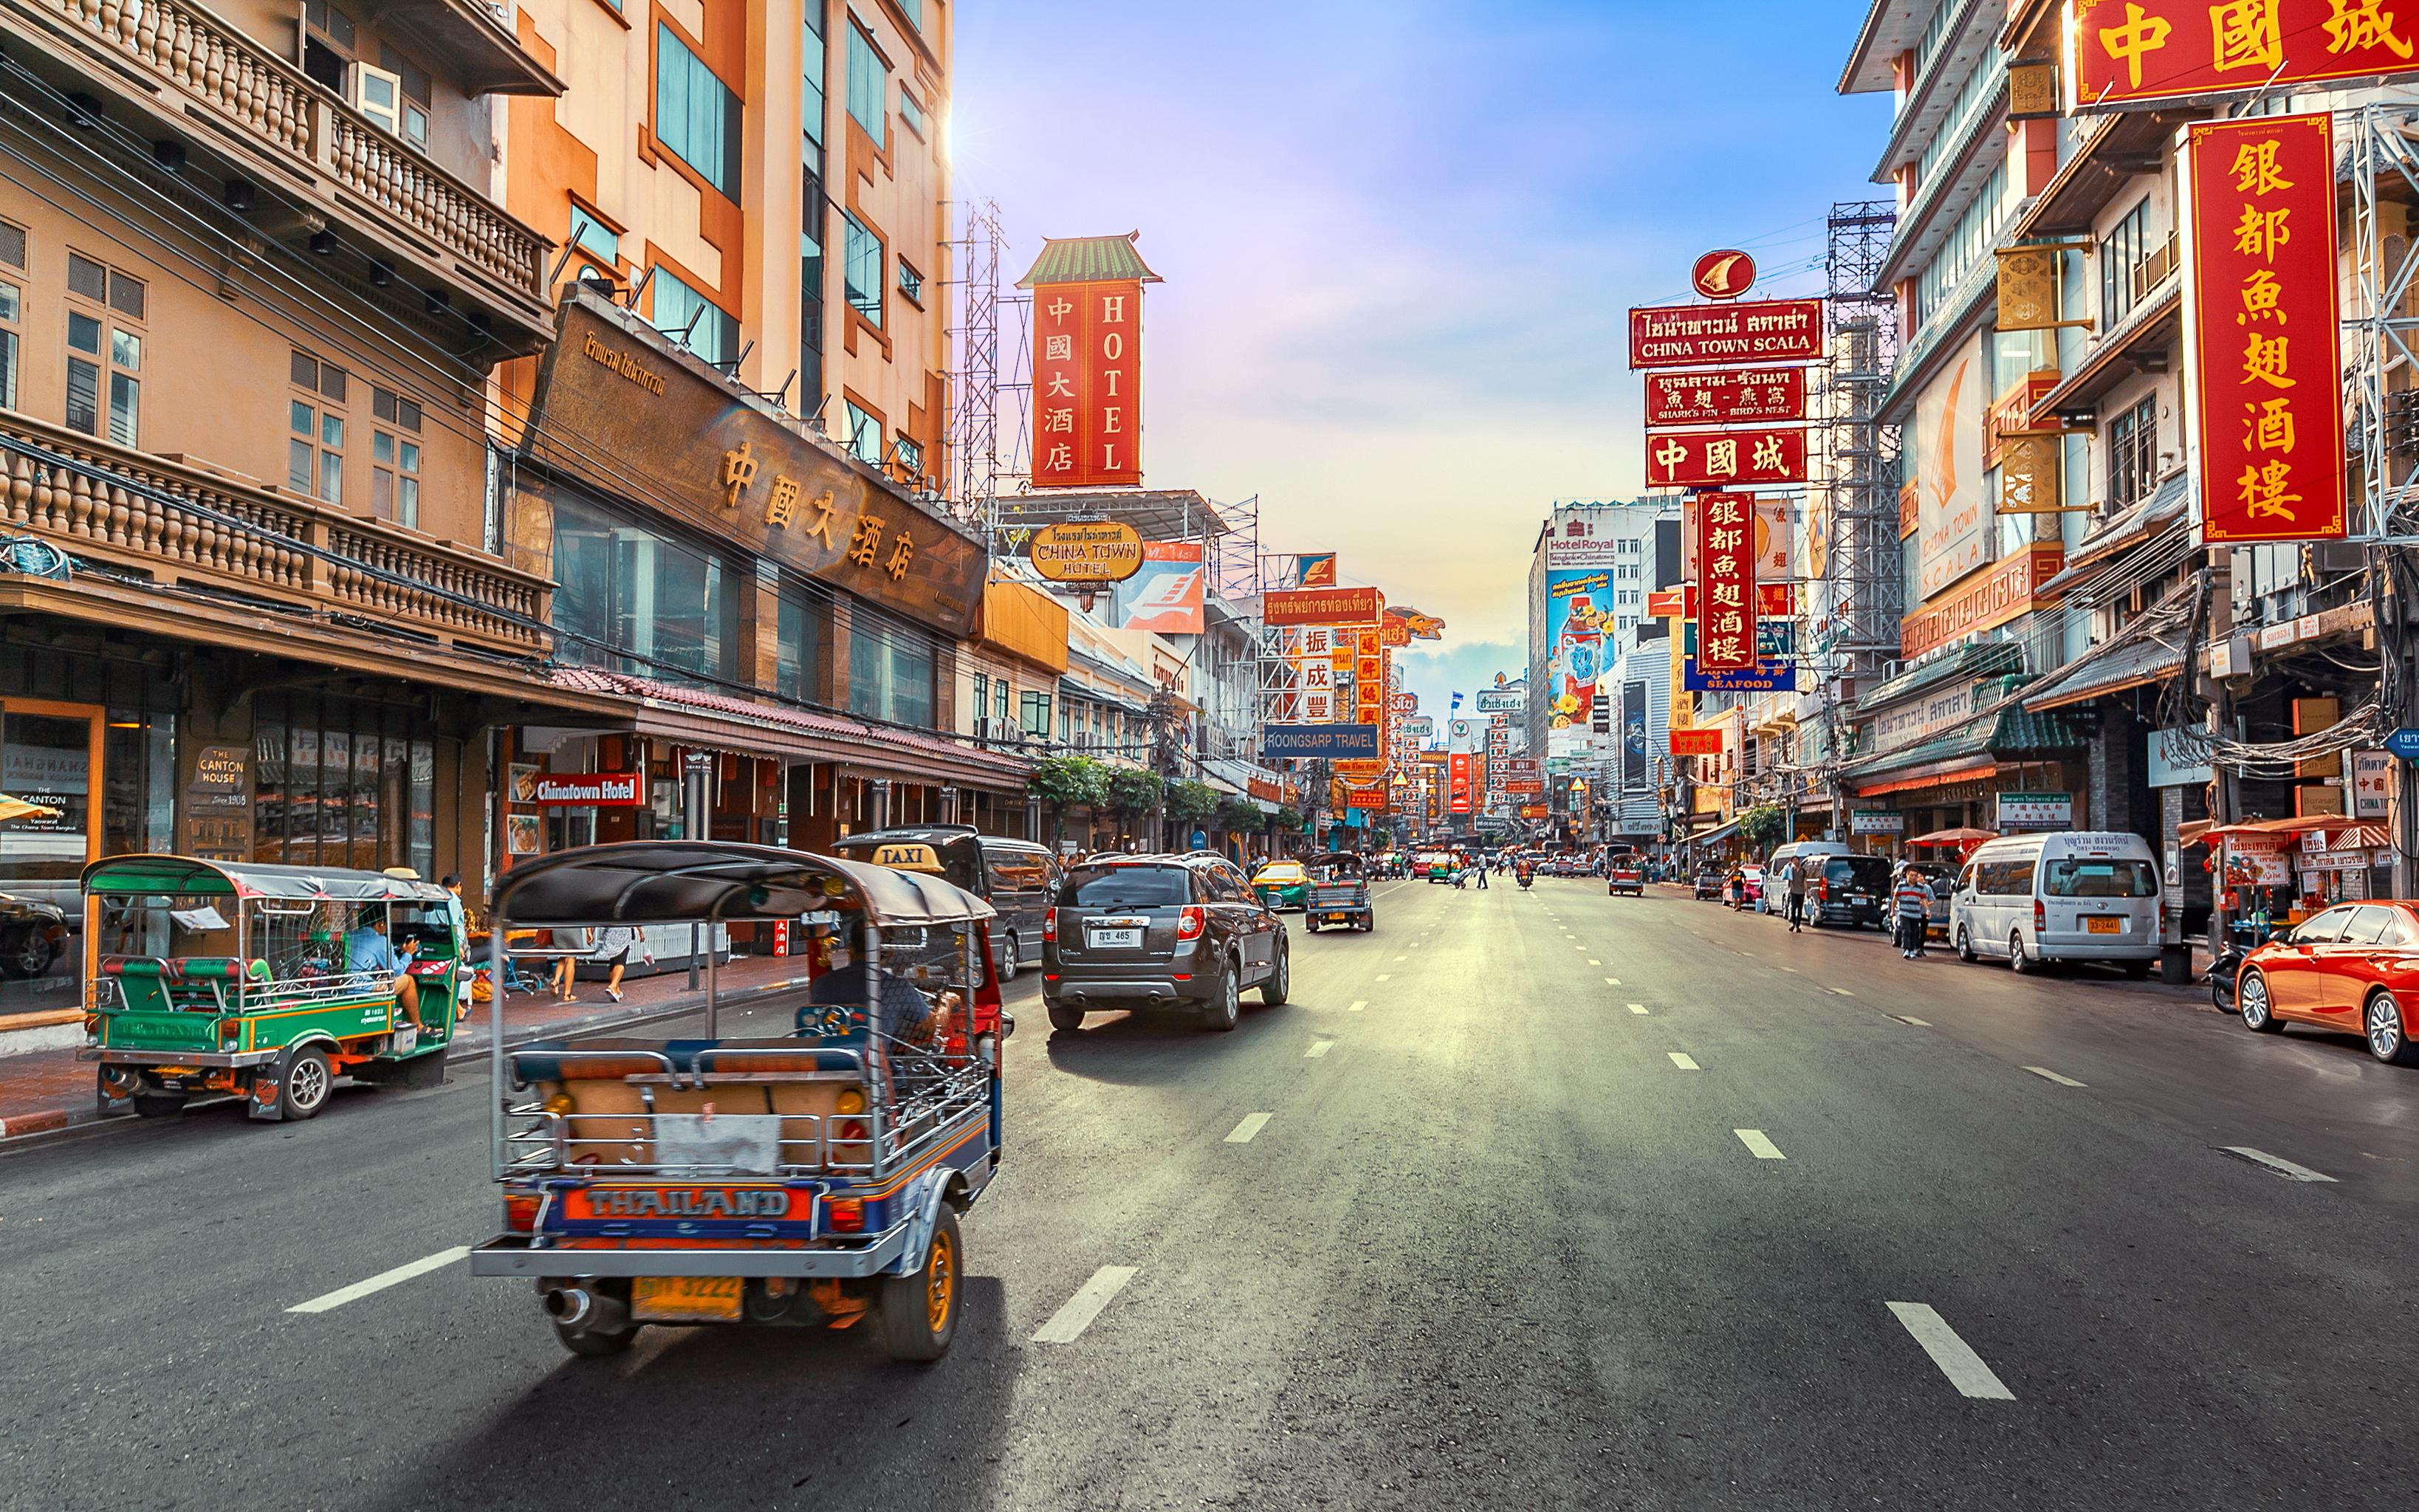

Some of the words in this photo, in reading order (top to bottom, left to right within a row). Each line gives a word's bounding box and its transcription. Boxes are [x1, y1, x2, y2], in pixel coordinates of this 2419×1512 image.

[2099, 0, 2414, 89] 中國城
[1642, 312, 1738, 337] ไชน่าทาวน์
[1747, 308, 1808, 331] สกาล่า
[2228, 139, 2303, 522] 銀都魚翅酒樓
[585, 331, 621, 371] โรงแรม
[1641, 342, 1694, 357] CHINA
[1698, 339, 1749, 354] TOWN
[1754, 335, 1810, 351] SCALA
[1043, 296, 1075, 472] 中國大酒店
[1102, 295, 1125, 471] HOTEL
[1658, 408, 1700, 419] SHARK'S
[1702, 408, 1718, 416] FIN
[1729, 407, 1763, 416] BIRD'S
[1766, 405, 1791, 414] NEST
[1655, 436, 1790, 481] 中國城
[725, 442, 914, 581] 中國大酒店
[1923, 530, 1949, 558] CHINA
[1953, 502, 1977, 533] TOWN
[1037, 543, 1086, 560] CHINA
[1091, 543, 1136, 560] TOWN
[1064, 563, 1111, 575] HOTEL
[1923, 543, 1977, 592] SCALA
[1707, 501, 1747, 662] 銀都魚翅酒樓
[1267, 590, 1373, 621] รุ่งทรัพย์การท่องเที่ยว
[1706, 680, 1773, 689] SEAFOOD
[1268, 732, 1331, 748] ROONGSARP
[1336, 734, 1373, 748] TRAVEL
[213, 749, 230, 759] THE
[199, 760, 244, 773] CANTON
[202, 772, 236, 784] HOUSE
[21, 795, 66, 804] CANTON
[537, 777, 600, 801] Chinatown
[602, 777, 635, 800] Hotel
[2360, 798, 2378, 809] CHINA
[882, 848, 924, 864] TAXI
[1116, 931, 1130, 940] 465
[590, 1190, 790, 1217] THAILAND
